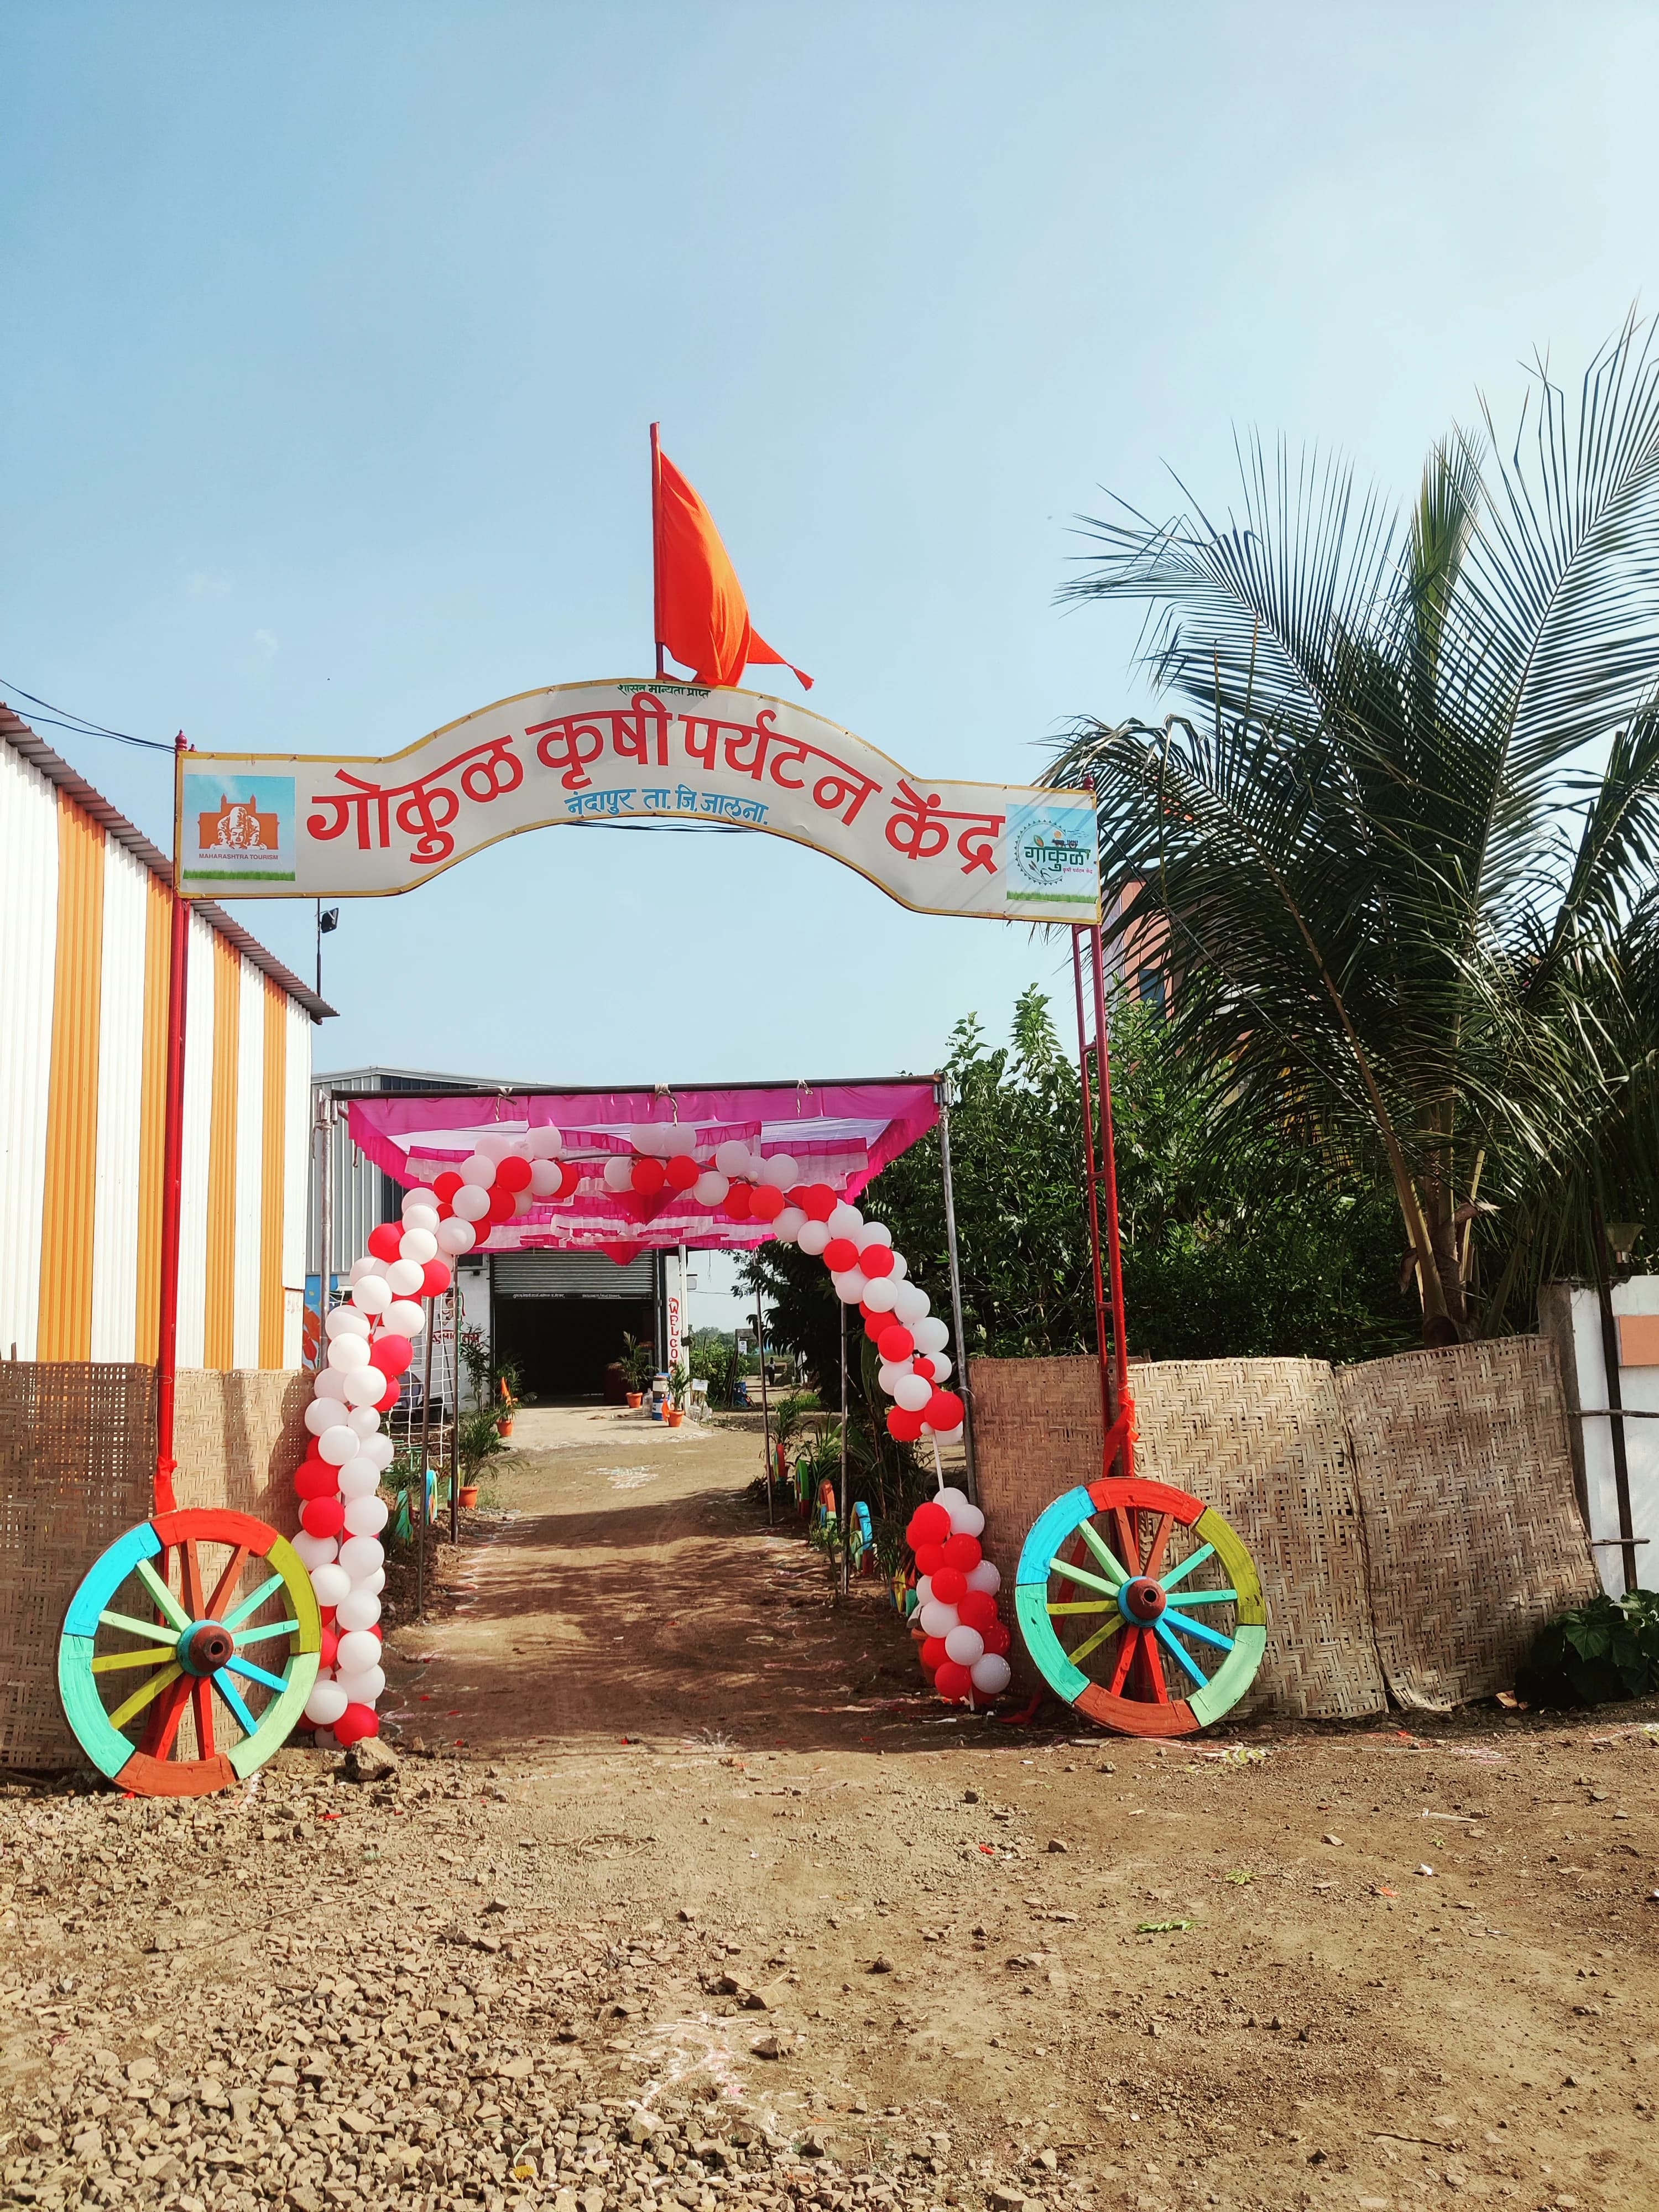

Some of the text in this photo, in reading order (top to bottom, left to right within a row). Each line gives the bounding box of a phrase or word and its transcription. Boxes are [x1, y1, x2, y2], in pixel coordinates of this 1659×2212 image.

[617, 684, 711, 698] शासन मान्यता प्राप्त
[307, 691, 1006, 875] गोकुळ कृषी पर्यटन केंद्र
[564, 789, 637, 816] नंदापुर
[641, 789, 671, 809] ता.
[701, 792, 769, 825] जालना.
